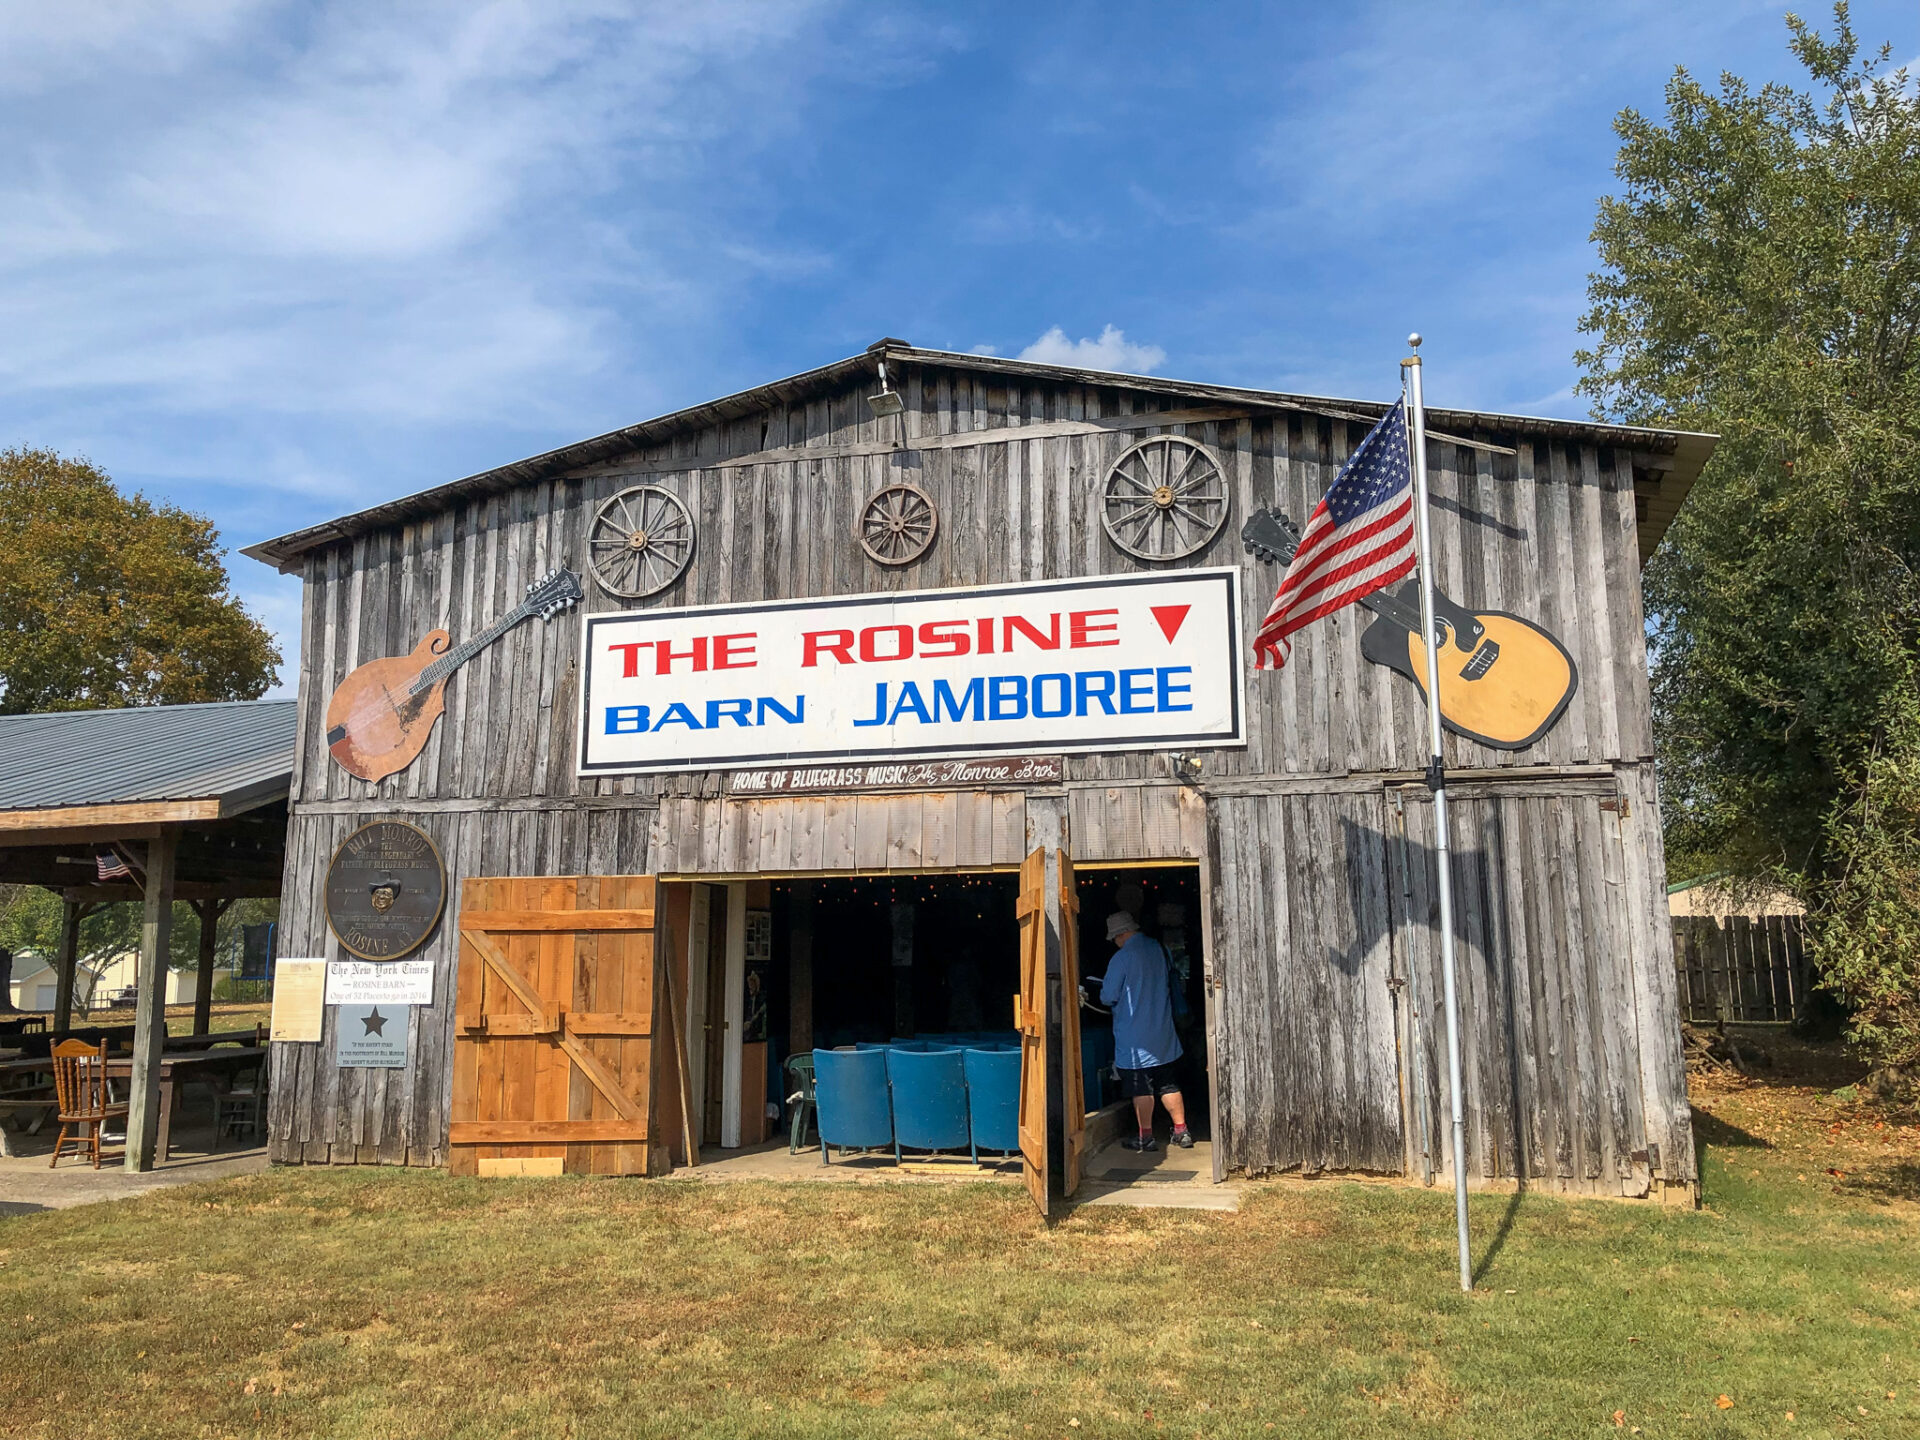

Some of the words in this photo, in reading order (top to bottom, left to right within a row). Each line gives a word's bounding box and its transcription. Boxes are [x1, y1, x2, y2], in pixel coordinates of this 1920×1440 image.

[608, 631, 758, 678] THE
[800, 607, 1121, 668] ROSINE
[603, 694, 805, 736] BARN
[853, 665, 1194, 728] JAMBOREE
[732, 771, 770, 790] HOME
[770, 770, 788, 788] OF
[790, 767, 862, 788] BLUEGRASS
[864, 765, 908, 785] MUSIC
[941, 760, 1010, 781] Monroe
[347, 829, 373, 855] BILL
[381, 825, 429, 857] MONROE
[344, 926, 389, 954] ROSINE
[331, 963, 348, 978] The
[351, 963, 371, 978] New
[375, 963, 398, 978] York
[402, 963, 430, 975] Times
[353, 981, 381, 989] ROSINE
[382, 981, 406, 989] BARN
